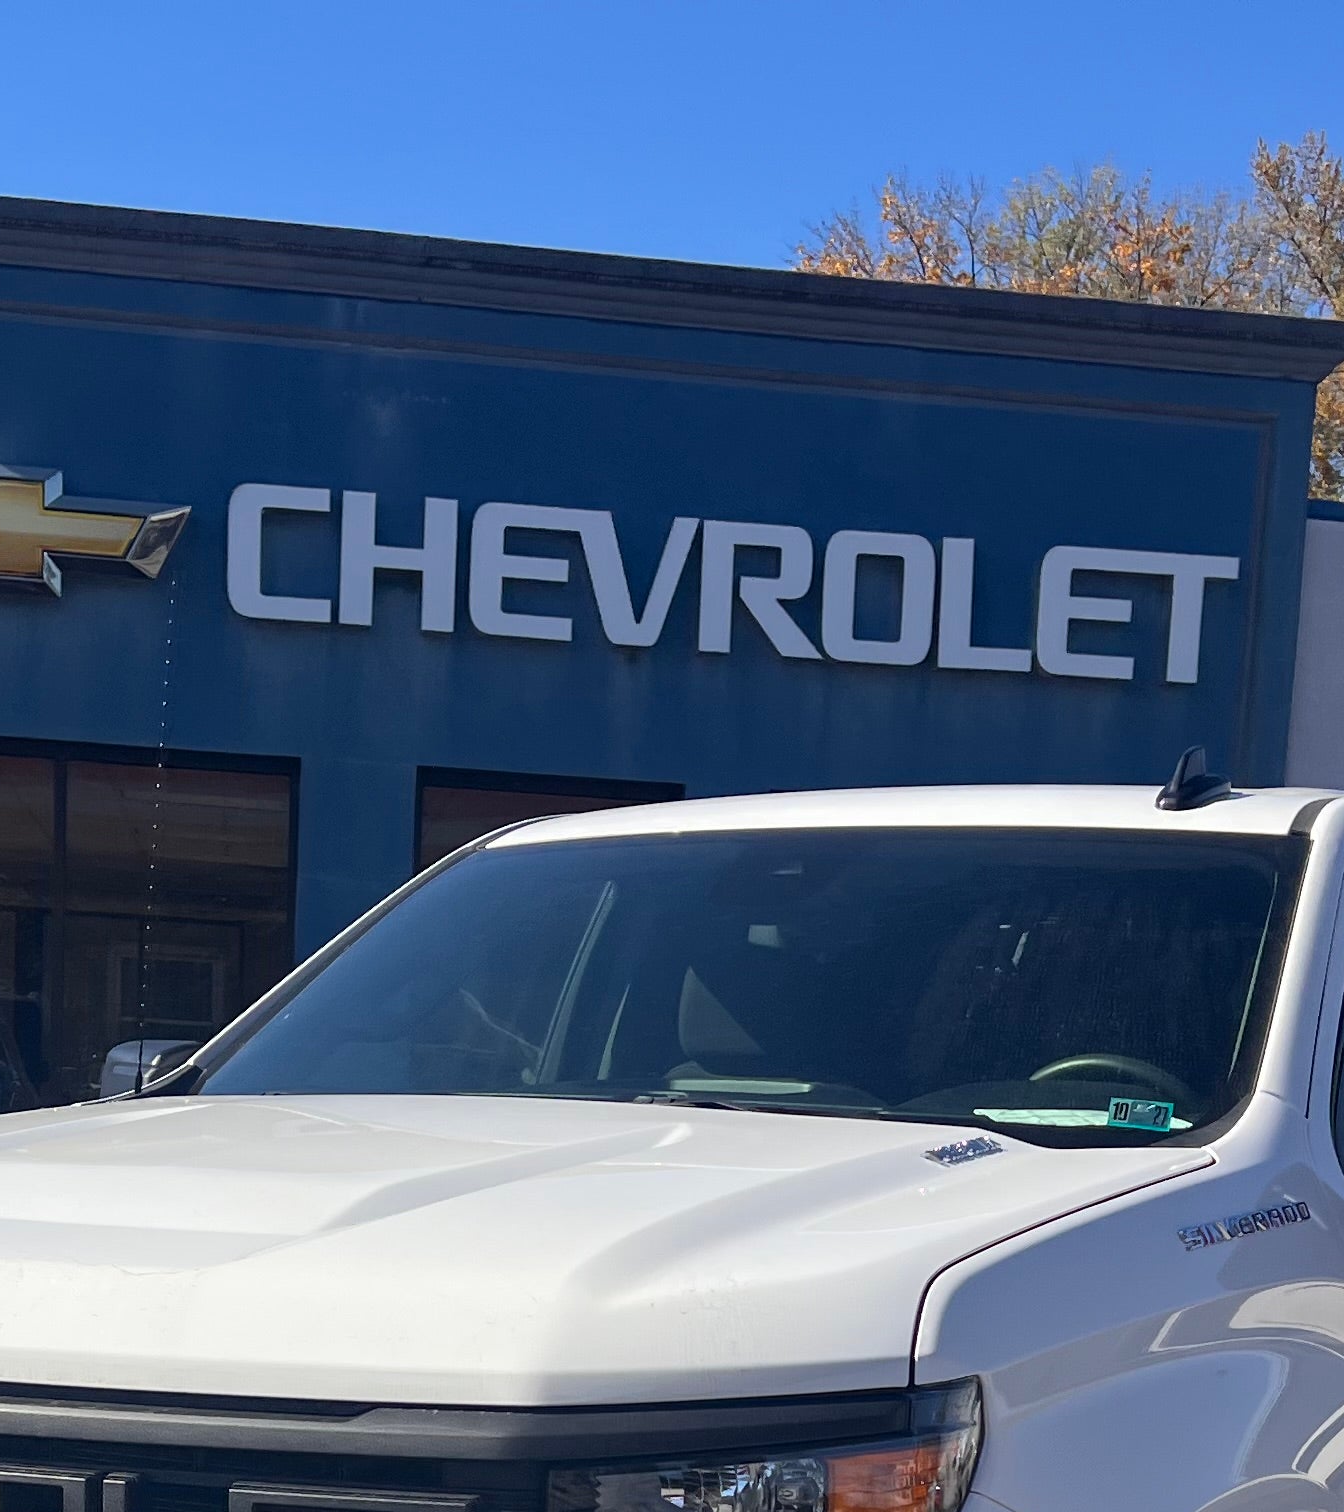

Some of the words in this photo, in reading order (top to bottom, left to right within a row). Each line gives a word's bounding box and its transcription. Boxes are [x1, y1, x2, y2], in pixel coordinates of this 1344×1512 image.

[227, 482, 1241, 685] CHEVROLET
[1113, 1102, 1130, 1121] 10
[1177, 1201, 1312, 1252] SILVERADO
